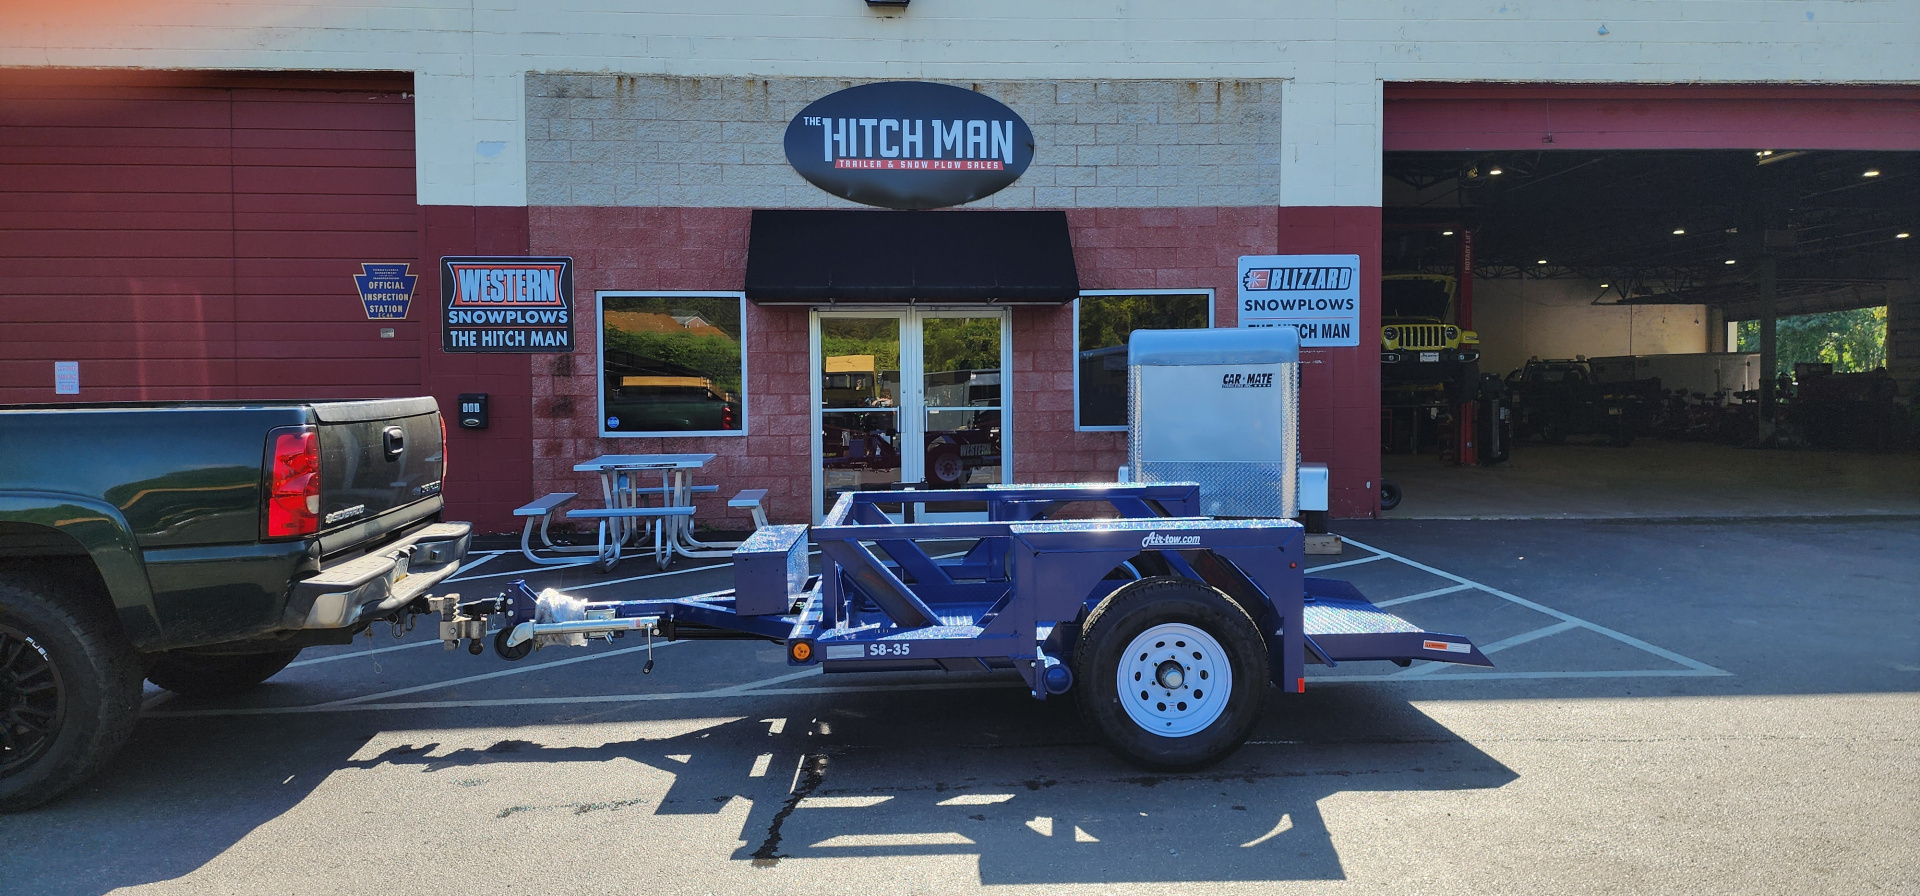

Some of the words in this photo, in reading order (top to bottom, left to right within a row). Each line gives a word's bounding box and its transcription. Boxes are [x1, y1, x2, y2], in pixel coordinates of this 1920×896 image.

[803, 116, 822, 126] THE
[822, 118, 923, 162] HITCH
[932, 119, 1013, 164] MAN
[839, 159, 882, 168] TRAILER
[887, 160, 894, 168] &
[900, 160, 929, 169] SNOW
[934, 161, 961, 169] PLOW
[967, 161, 999, 169] SALES
[368, 281, 405, 290] OFFICIAL
[458, 268, 556, 303] WESTERN
[1269, 268, 1352, 290] BLIZZARD
[364, 293, 409, 301] INSPECTION
[369, 304, 403, 313] STATION
[1244, 298, 1354, 312] SNOWPLOWS
[448, 310, 568, 324] SNOWPLOWS
[1321, 323, 1350, 339] MAN
[450, 330, 477, 347] THE
[481, 330, 525, 347] HITCH
[530, 330, 568, 347] MAN
[1141, 531, 1201, 548] Air-tow.com
[869, 643, 910, 656] S8-35
